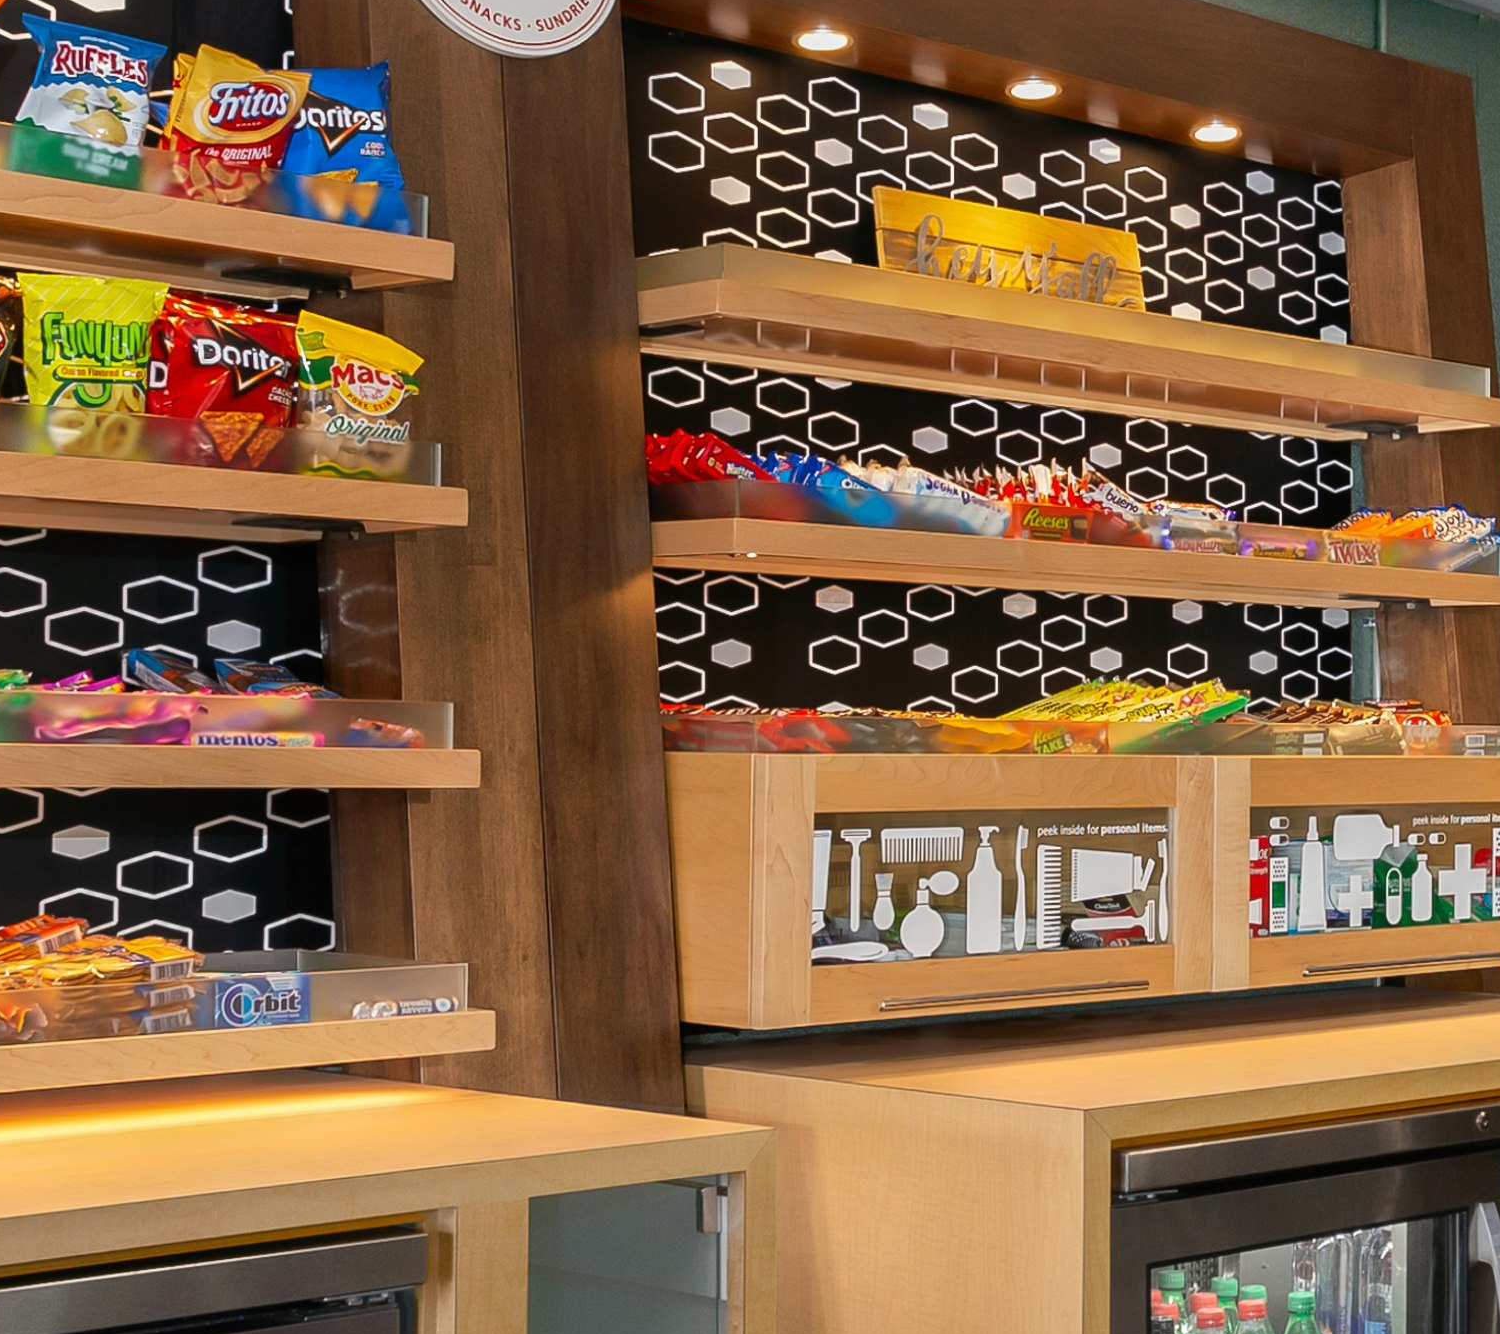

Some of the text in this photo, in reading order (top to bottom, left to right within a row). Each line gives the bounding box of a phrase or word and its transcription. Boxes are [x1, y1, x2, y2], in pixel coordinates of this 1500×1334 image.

[53, 41, 149, 85] RUFFLES
[209, 81, 290, 126] Fritos
[221, 145, 273, 161] ORIGINAL
[331, 362, 405, 391] Macs
[326, 415, 410, 444] Original
[1105, 487, 1139, 514] bueno
[1022, 506, 1070, 530] Reese's
[1037, 822, 1169, 838] peek inside for personal items.
[1412, 815, 1429, 827] peek
[1430, 813, 1449, 826] inside
[1450, 814, 1460, 825] for
[1460, 813, 1491, 826] personal
[222, 982, 301, 1028] Orbit
